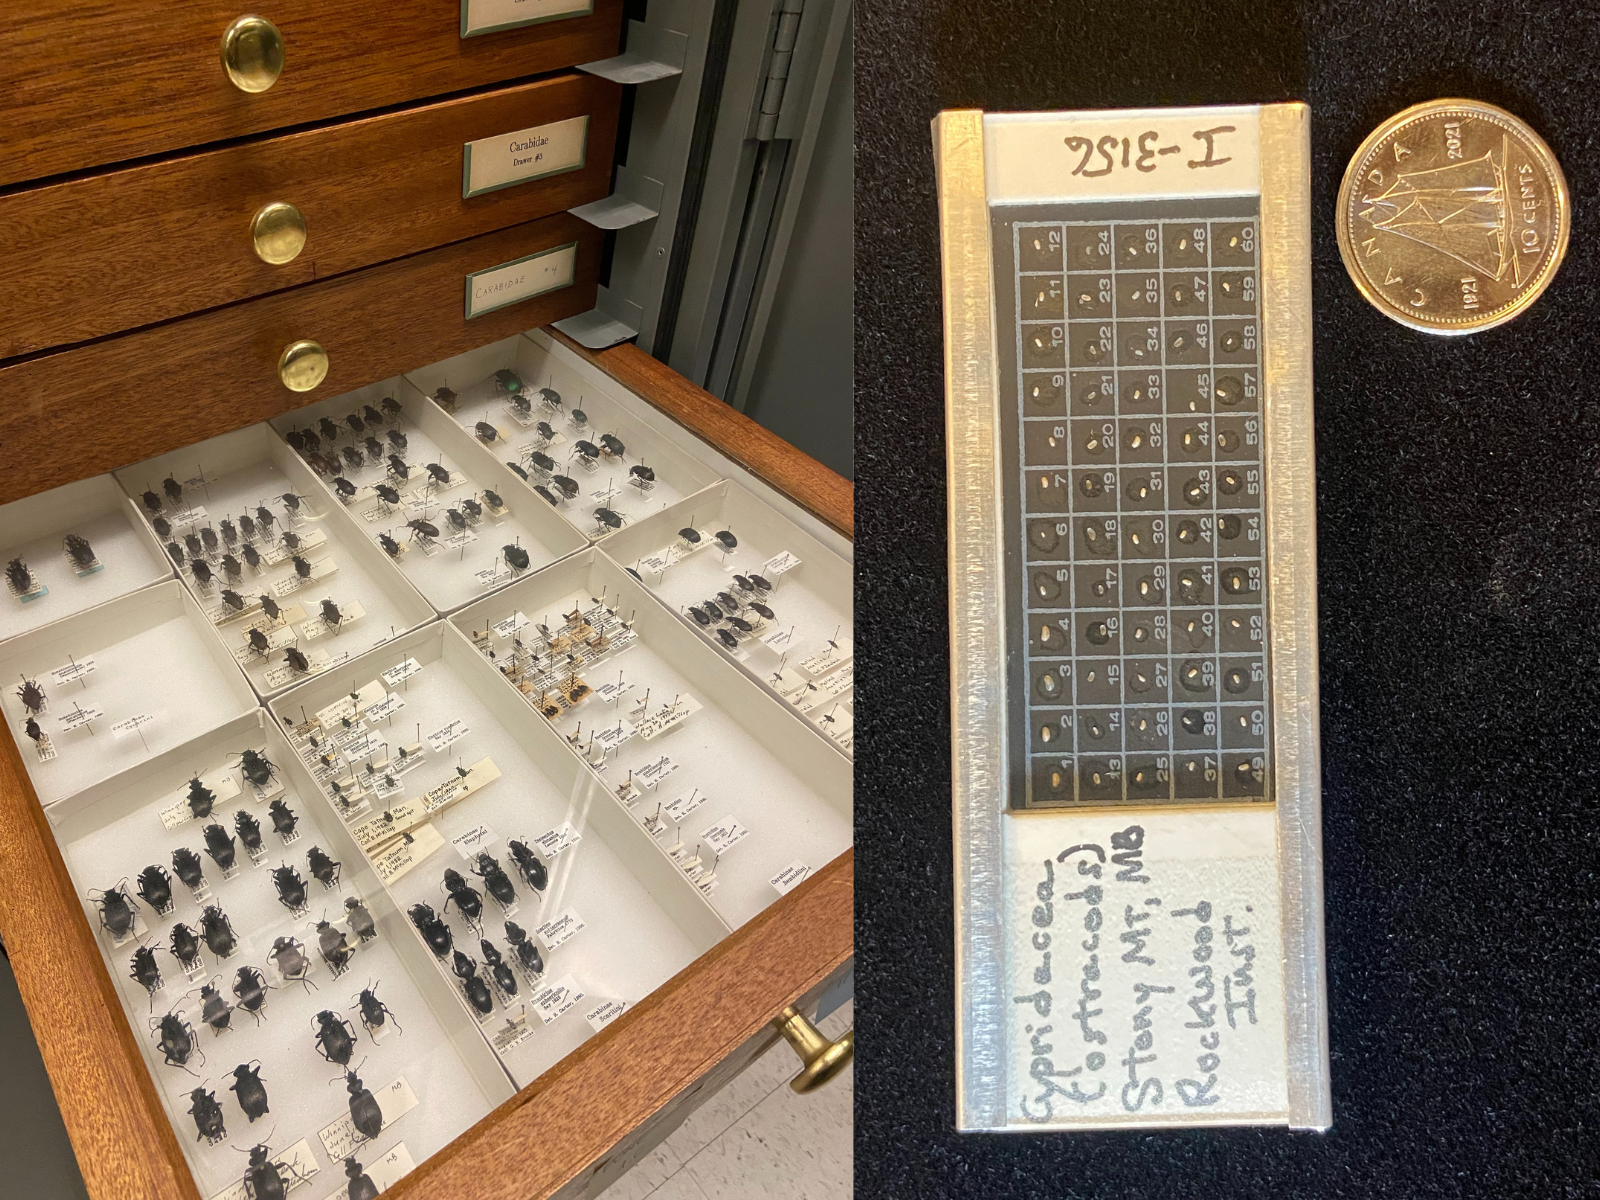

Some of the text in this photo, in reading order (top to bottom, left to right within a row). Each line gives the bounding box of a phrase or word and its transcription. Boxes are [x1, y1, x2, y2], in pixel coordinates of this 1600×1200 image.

[509, 136, 549, 153] Carabidae
[1444, 122, 1462, 160] 2021
[512, 153, 543, 167] Drawer #3
[1518, 163, 1540, 253] 10 CENTS
[1049, 230, 1060, 252] 12
[1098, 230, 1110, 255] 24
[1145, 229, 1158, 253] 36
[1193, 229, 1205, 254] 48
[1241, 227, 1255, 252] 60
[475, 274, 526, 299] CARABIDAE
[1049, 279, 1060, 297] 11
[1100, 278, 1112, 303] 23
[1147, 278, 1158, 304] 35
[1195, 278, 1206, 301] 47
[1243, 277, 1255, 301] 59
[1462, 277, 1477, 309] 1921
[1051, 326, 1063, 347] 10
[1101, 326, 1112, 351] 22
[1147, 326, 1159, 351] 34
[1196, 324, 1208, 348] 46
[1244, 326, 1256, 350] 58
[1052, 375, 1064, 387] 9
[1102, 374, 1114, 395] 21
[1148, 374, 1160, 399] 33
[1198, 374, 1209, 398] 45
[1245, 373, 1257, 398] 57
[1053, 426, 1065, 438] 8
[1102, 423, 1115, 448] 20
[1149, 422, 1162, 448] 32
[1198, 422, 1210, 446] 44
[1245, 421, 1258, 445] 56
[1055, 475, 1067, 488] 7
[1103, 472, 1116, 493] 19
[1150, 470, 1162, 491] 31
[1199, 470, 1211, 493] 43
[1247, 470, 1260, 495] 55
[1055, 523, 1067, 535] 6
[1105, 520, 1117, 540] 18
[1152, 519, 1164, 544] 30
[1201, 517, 1213, 542] 42
[1248, 516, 1260, 541] 54
[1056, 570, 1068, 581] 5
[1105, 568, 1117, 589] 17
[1154, 566, 1166, 590] 29
[1201, 565, 1213, 585] 41
[1248, 566, 1261, 591] 53
[1058, 618, 1070, 630] 4
[1106, 618, 1119, 638] 16
[1155, 615, 1167, 640] 28
[1201, 612, 1214, 636] 40
[1250, 615, 1262, 641] 52
[1059, 665, 1072, 677] 3
[1107, 665, 1119, 685] 15
[1155, 663, 1168, 688] 27
[1202, 662, 1214, 687] 39
[1251, 661, 1264, 682] 51
[1061, 715, 1073, 727] 2
[1108, 712, 1120, 731] 14
[1156, 711, 1169, 735] 26
[1203, 712, 1215, 736] 38
[1252, 710, 1264, 735] 50
[1062, 759, 1073, 767] 1
[1156, 757, 1169, 782] 25
[1204, 756, 1217, 781] 37
[1251, 757, 1265, 782] 49
[353, 825, 368, 835] Cape
[392, 806, 406, 814] Man.
[452, 828, 478, 844] Carabinae
[1110, 824, 1150, 884] MB
[770, 867, 793, 884] Carabinae
[1057, 843, 1107, 1103] (ostracods)
[558, 1002, 573, 1012] Carter,
[586, 1002, 612, 1020] Carabinae
[1171, 900, 1220, 1107] Rockwood
[1122, 981, 1175, 1112] Stony
